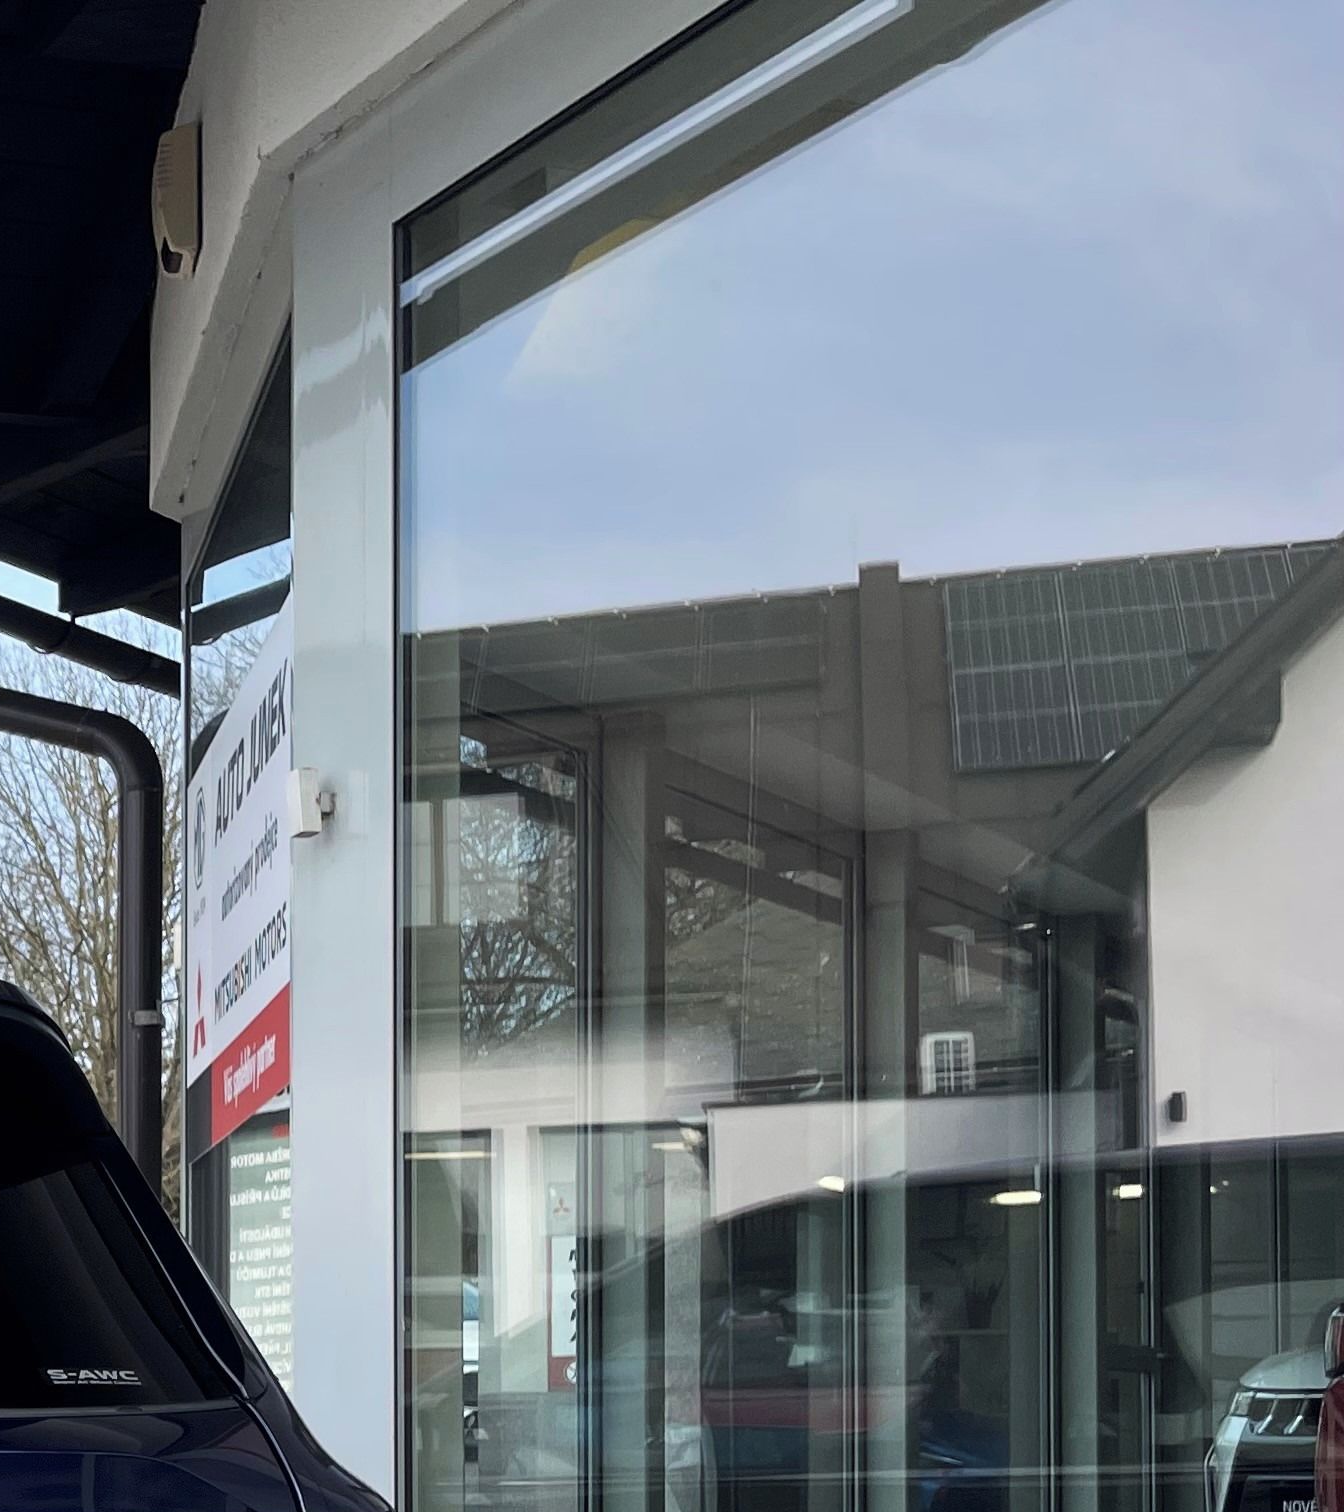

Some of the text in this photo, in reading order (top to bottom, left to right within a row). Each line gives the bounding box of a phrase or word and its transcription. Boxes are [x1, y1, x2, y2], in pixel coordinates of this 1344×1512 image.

[215, 657, 288, 849] AUTO JUNEK
[254, 809, 279, 891] prodejce
[214, 901, 288, 1025] MITSUBISHI MOTORS
[46, 1369, 139, 1381] S-AWC
